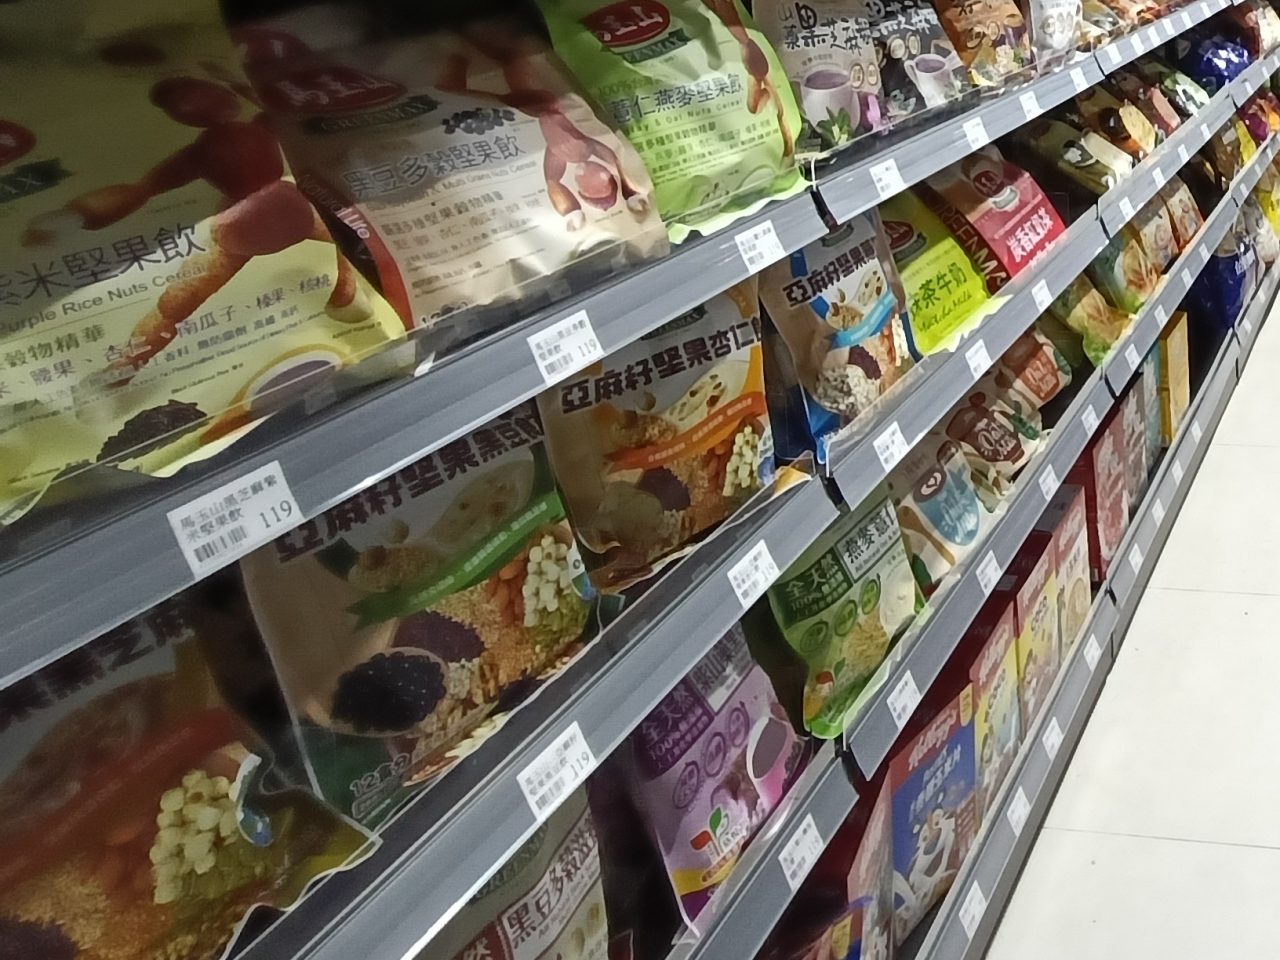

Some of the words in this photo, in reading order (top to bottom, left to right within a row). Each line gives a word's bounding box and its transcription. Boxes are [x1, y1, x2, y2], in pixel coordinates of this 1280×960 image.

[61, 293, 104, 316] Rice
[106, 280, 149, 305] Nuts
[578, 338, 598, 358] 119
[561, 315, 763, 415] 亞麻籽堅果杏仁
[260, 499, 293, 530] 119
